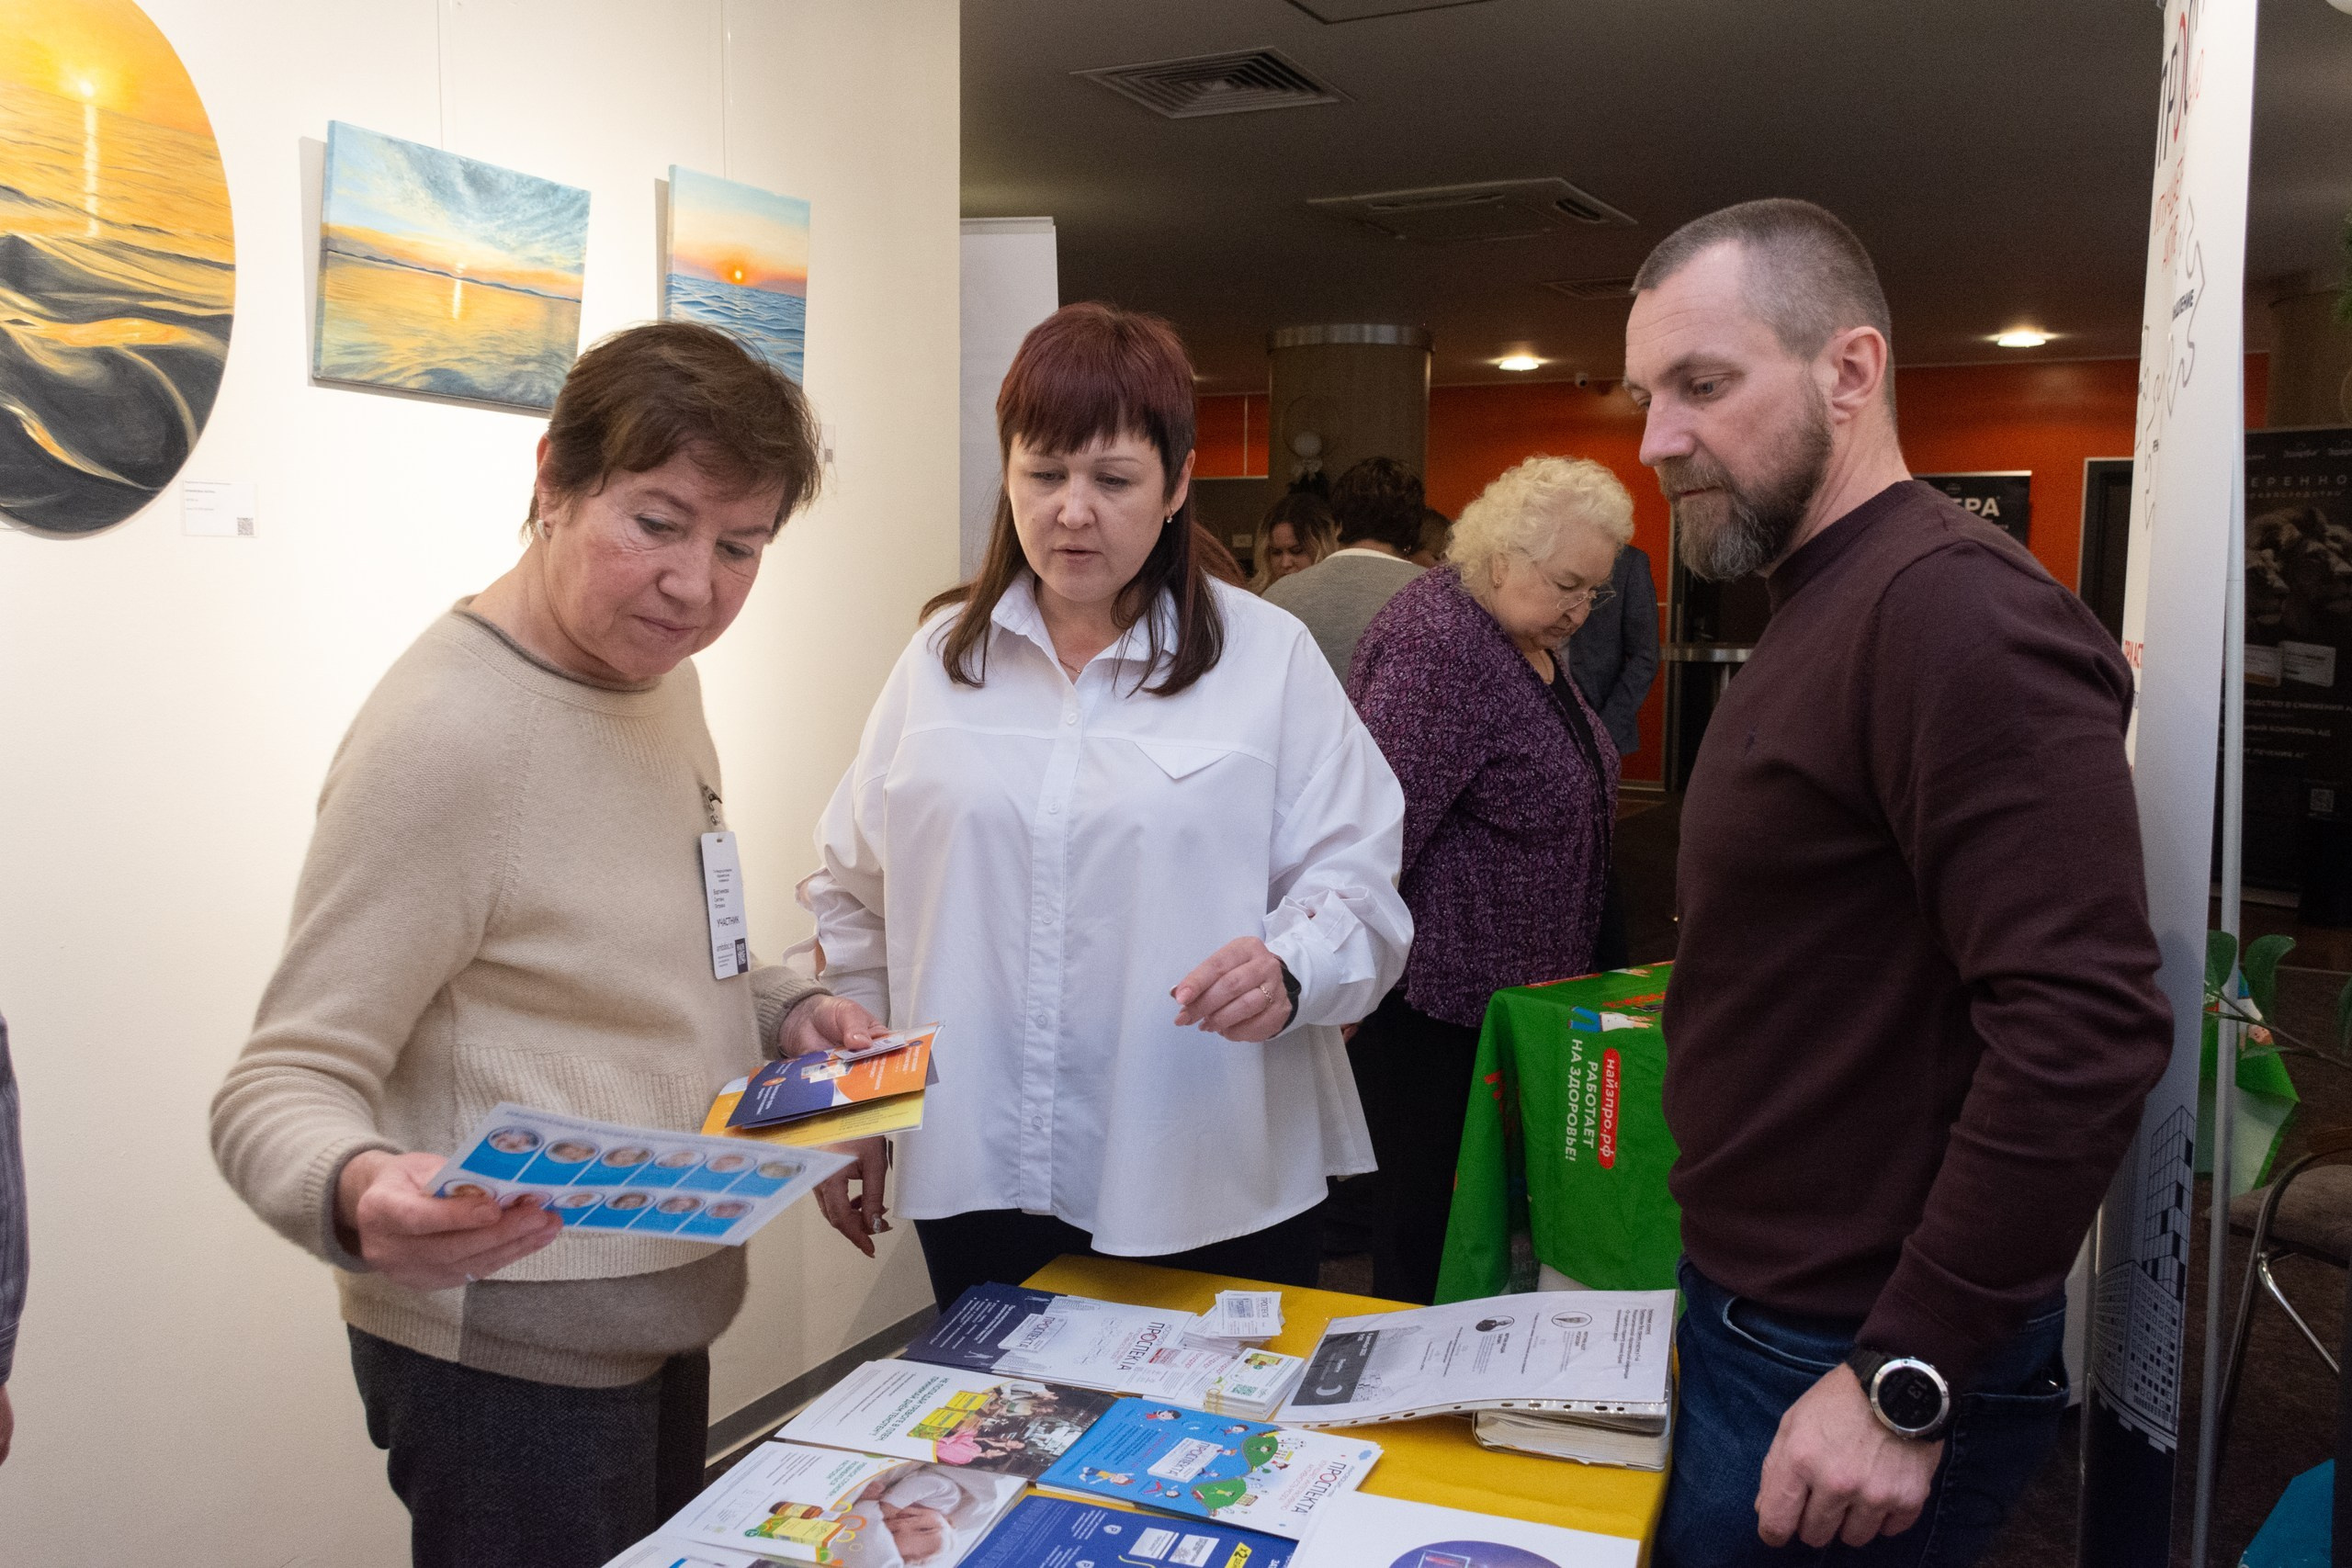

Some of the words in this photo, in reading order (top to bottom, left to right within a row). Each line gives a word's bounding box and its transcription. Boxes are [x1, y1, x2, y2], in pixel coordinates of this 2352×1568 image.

[1570, 1039, 1583, 1063] НА
[1565, 1066, 1581, 1162] ЗДОРОВЬЕ!
[1583, 1061, 1599, 1149] РАБОТАЕТ
[1600, 1059, 1618, 1157] найзпро.рф
[1114, 1321, 1167, 1372] ПРОСПЕКТА
[1290, 1461, 1348, 1515] ПРОСПЕКТА
